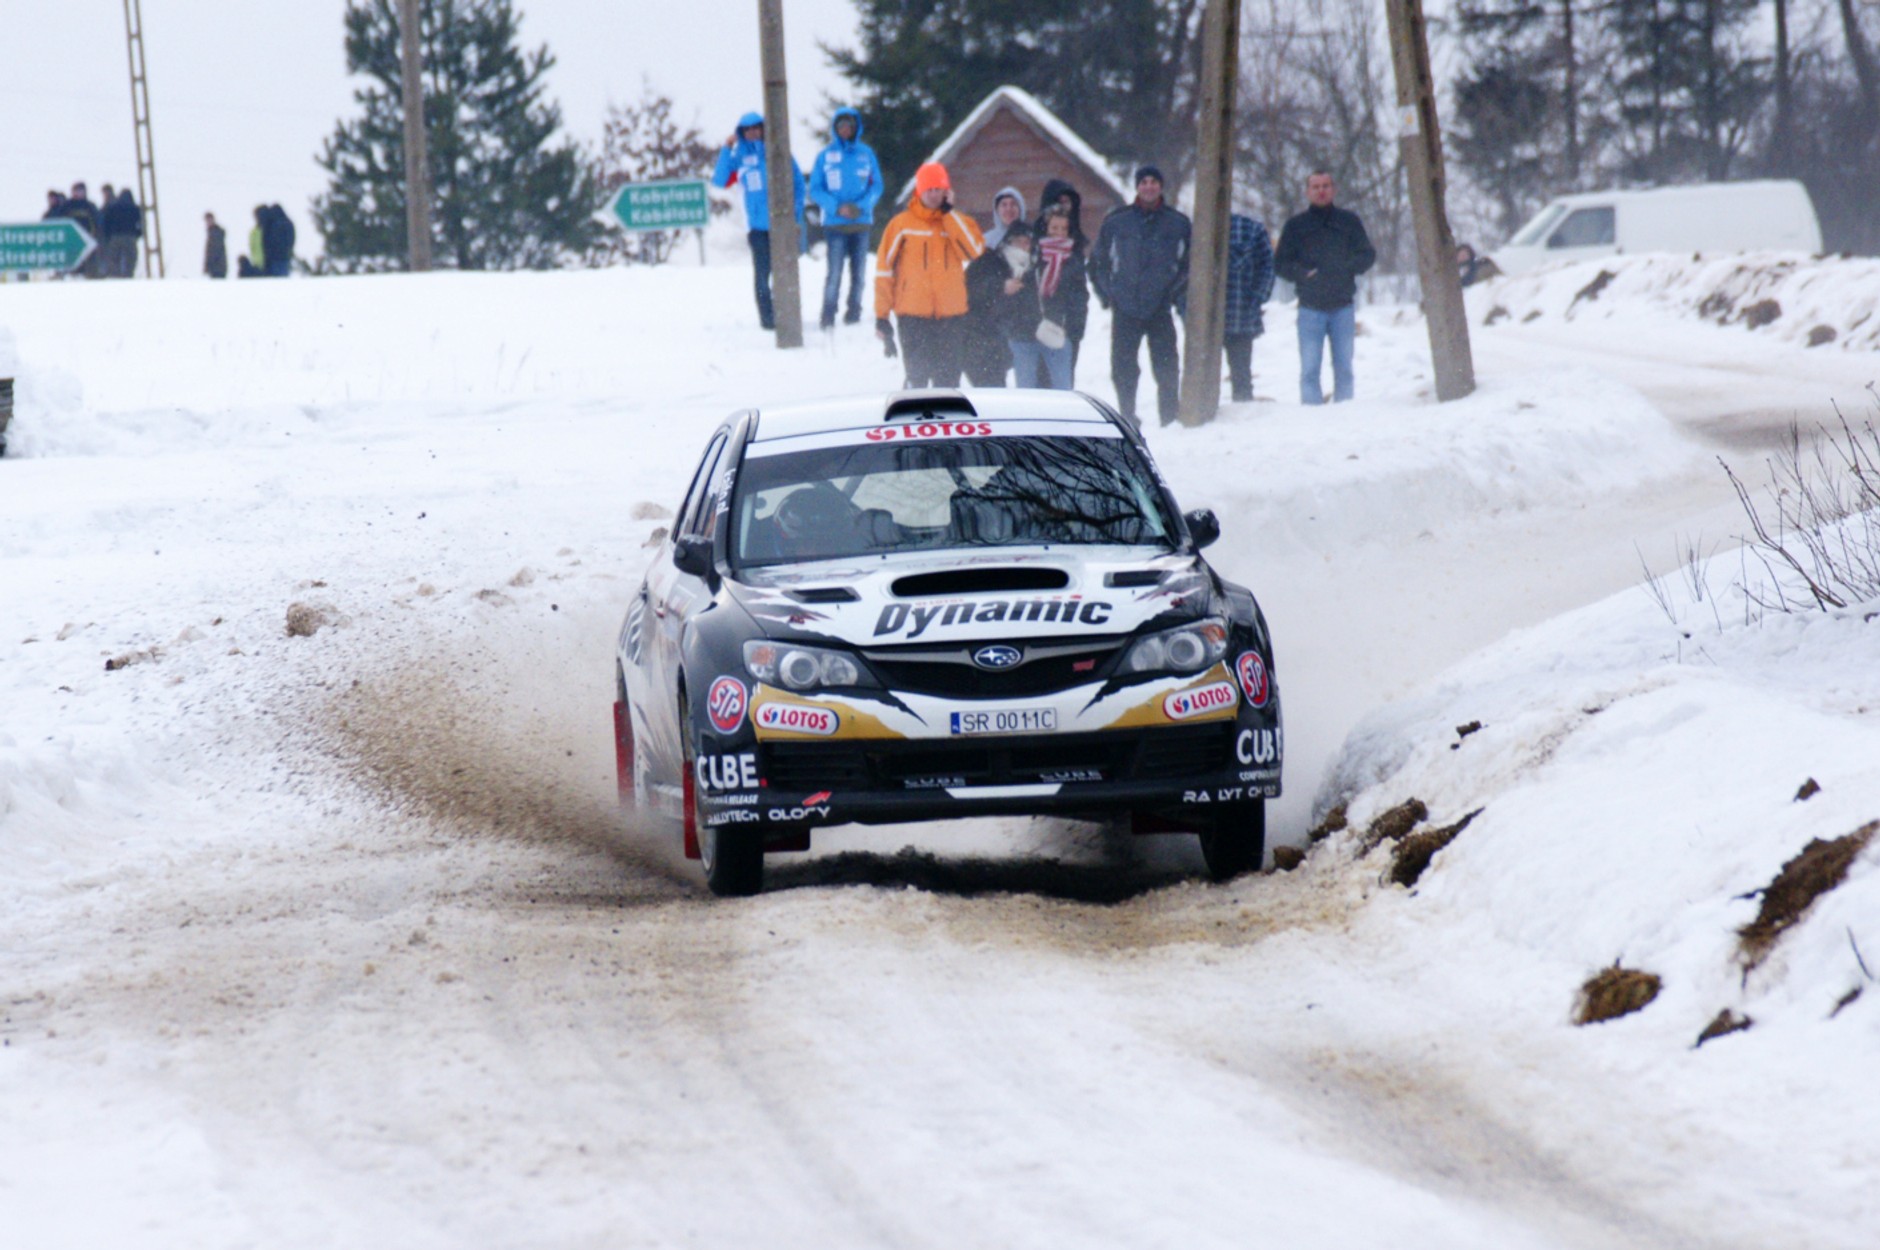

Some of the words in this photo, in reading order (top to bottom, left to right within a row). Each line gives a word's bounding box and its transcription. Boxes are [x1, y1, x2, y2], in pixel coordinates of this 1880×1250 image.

[902, 422, 992, 438] LOTOS
[872, 595, 1113, 639] Dynamic
[1245, 658, 1263, 698] STP
[710, 684, 741, 720] STP
[1190, 686, 1232, 709] LOTOS
[780, 708, 829, 731] LOTOS
[963, 713, 989, 732] SR
[996, 710, 1052, 730] 0011C
